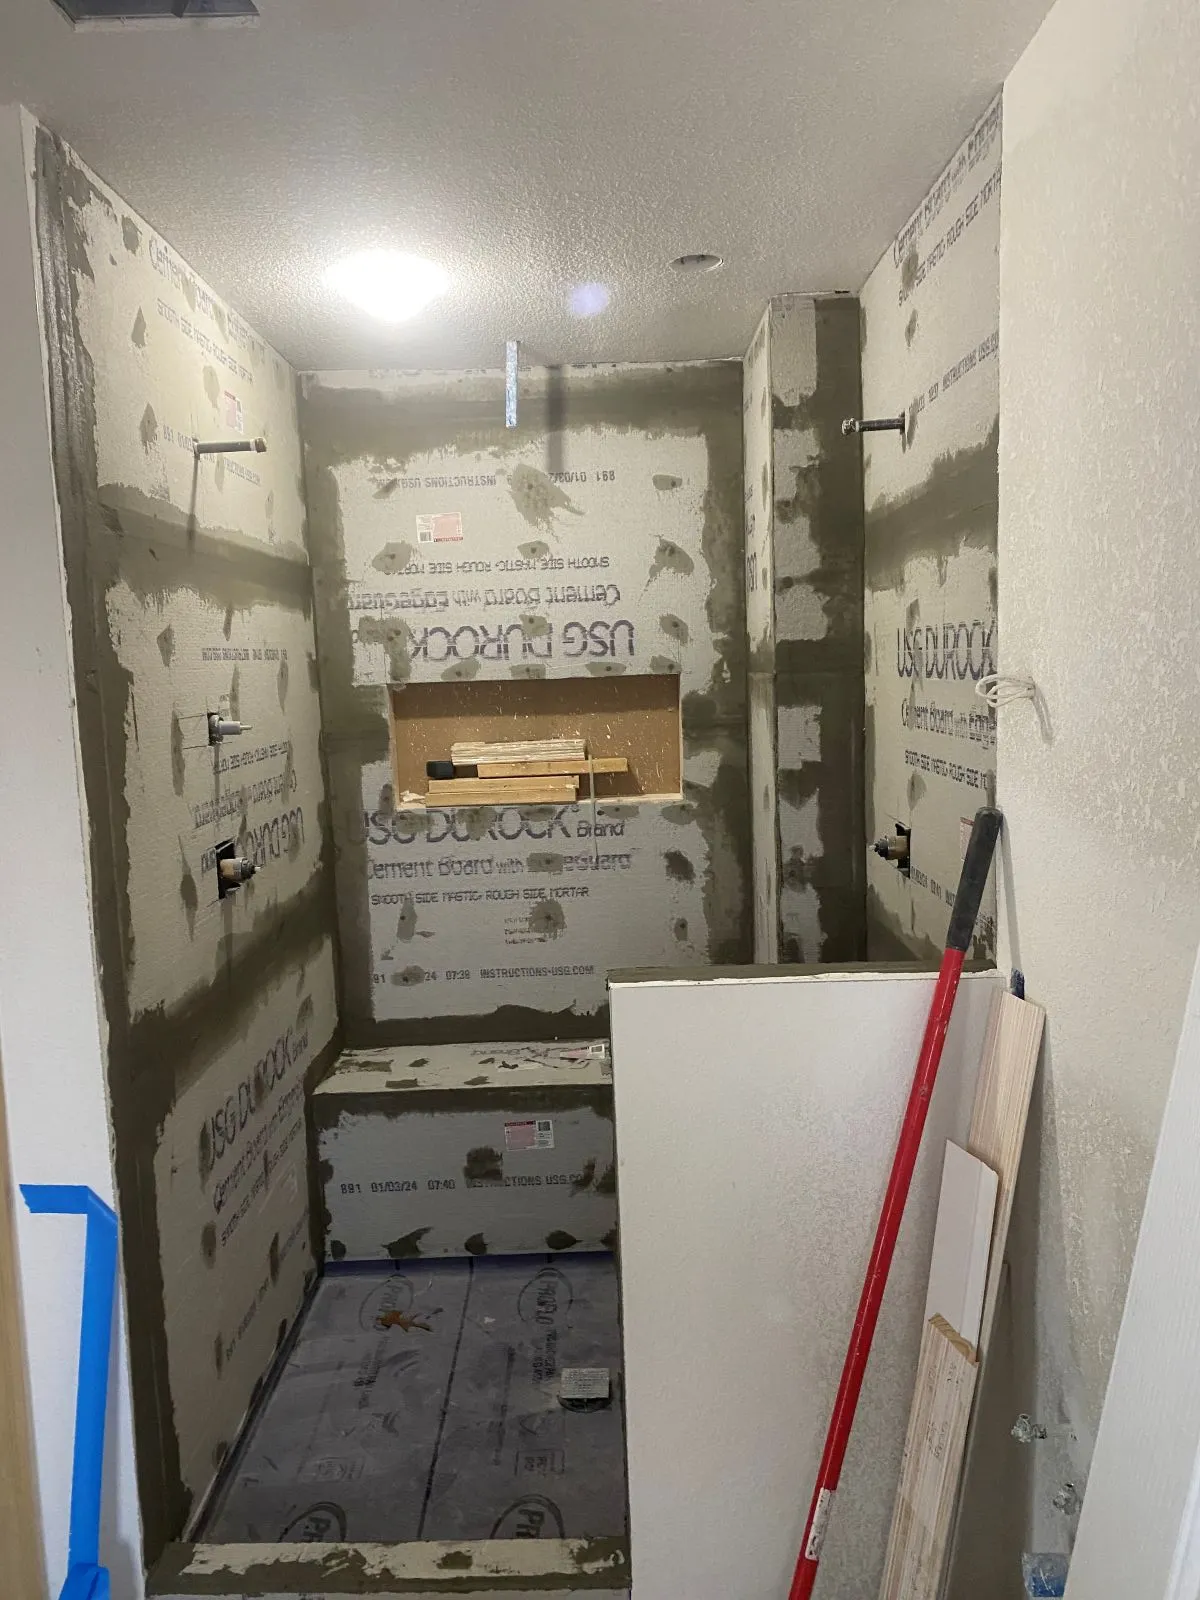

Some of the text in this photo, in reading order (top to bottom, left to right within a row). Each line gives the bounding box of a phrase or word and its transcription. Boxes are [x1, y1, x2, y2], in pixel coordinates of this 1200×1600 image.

[596, 470, 615, 482] 891
[456, 561, 492, 574] ROUGH
[452, 589, 481, 607] with
[484, 587, 542, 608] Board
[545, 583, 621, 607] Cement
[404, 619, 635, 662] USG DUROCK
[576, 818, 626, 839] Brand
[438, 855, 493, 877] Board
[485, 888, 520, 901] ROUGH
[372, 973, 387, 984] 91
[371, 1180, 418, 1193] 01/03/24
[427, 1179, 456, 1191] 07:40
